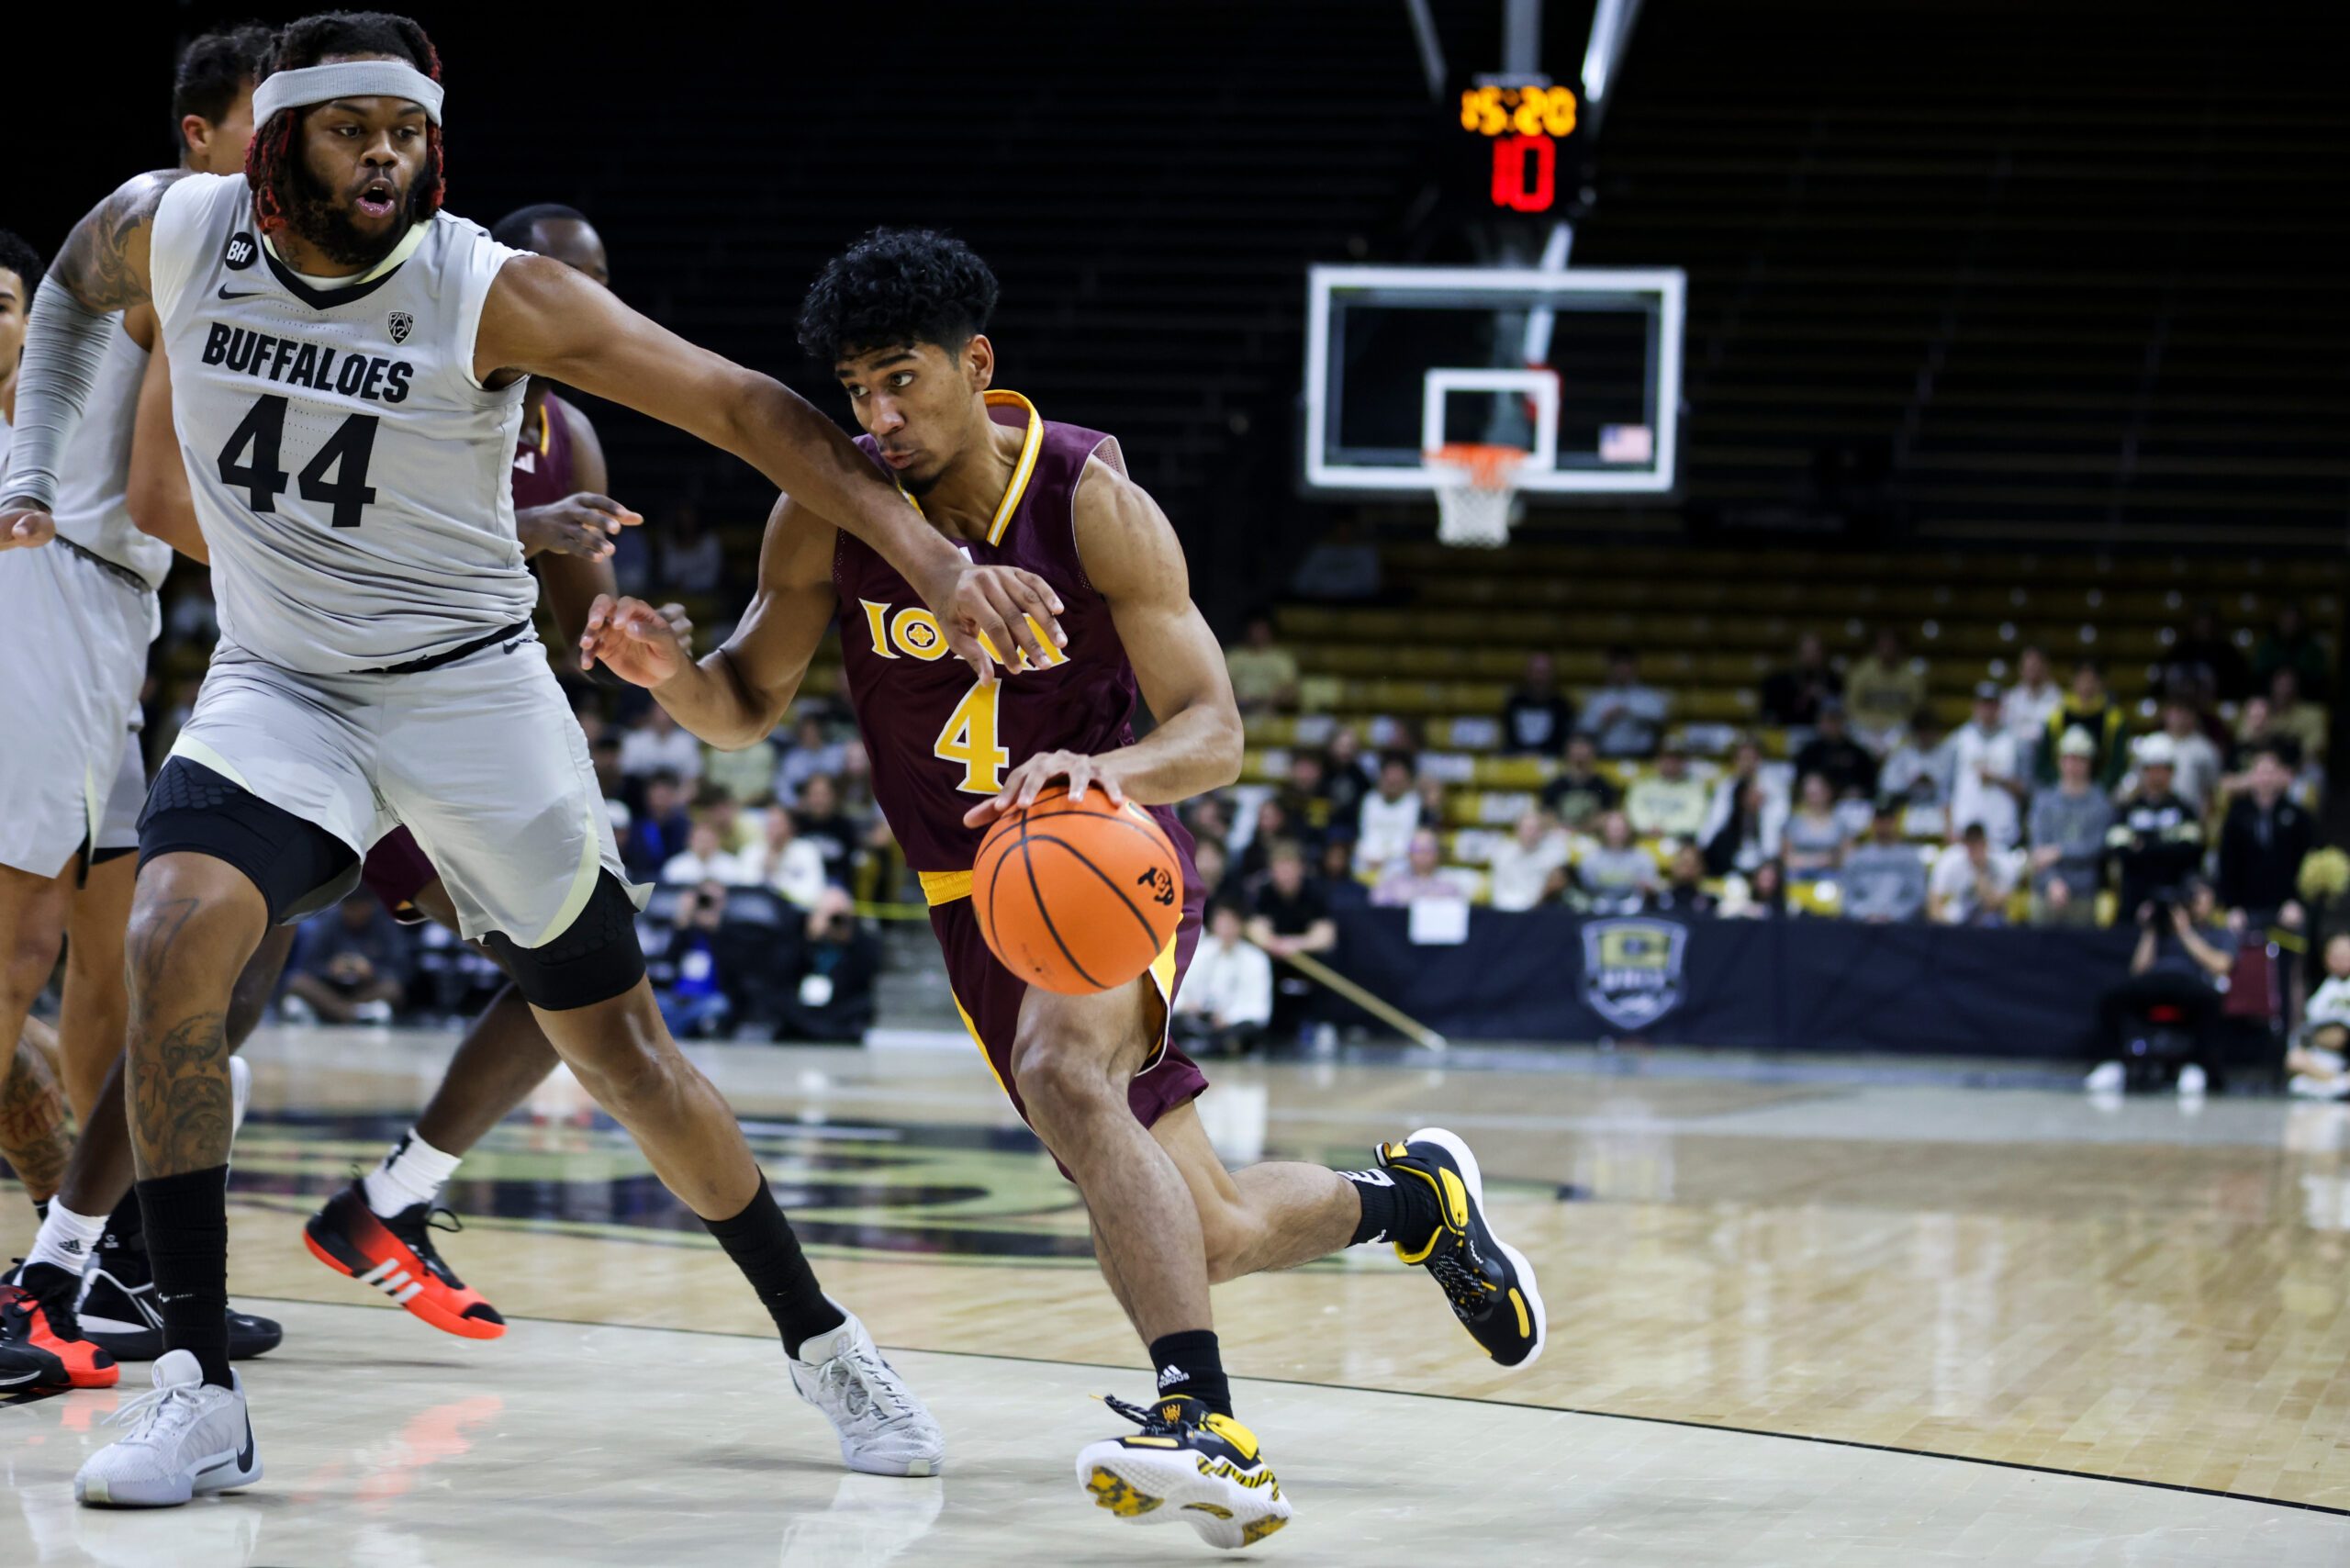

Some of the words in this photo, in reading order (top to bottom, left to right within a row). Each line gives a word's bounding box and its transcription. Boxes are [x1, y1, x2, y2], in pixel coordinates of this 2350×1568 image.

[226, 240, 253, 263] BH
[389, 312, 414, 332] PAC
[393, 326, 406, 338] 12
[202, 322, 414, 404] BUFFALOES
[217, 393, 380, 528] 44
[858, 598, 1071, 671] IOA
[934, 678, 1010, 795] 4
